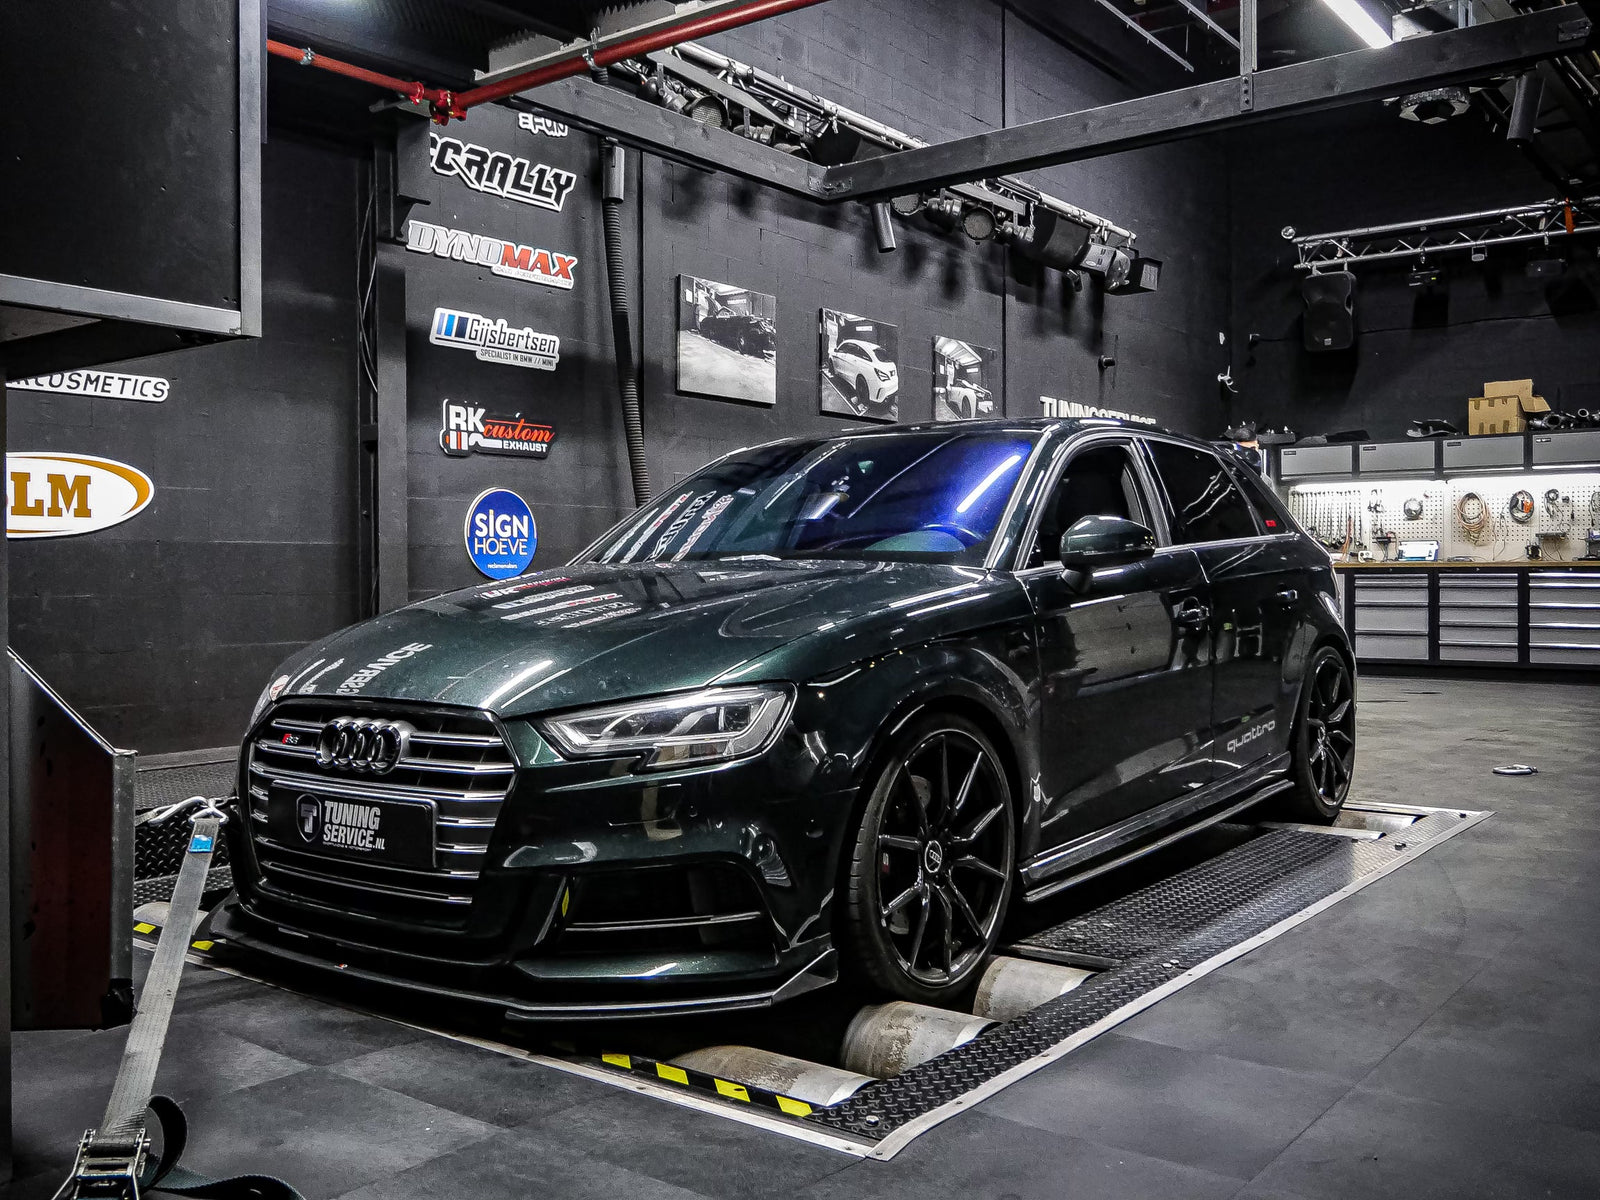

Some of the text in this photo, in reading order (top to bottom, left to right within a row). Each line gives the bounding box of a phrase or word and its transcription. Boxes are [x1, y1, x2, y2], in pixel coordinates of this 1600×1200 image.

[408, 222, 576, 281] DYNOMAX
[469, 318, 557, 353] Gijsbertsen
[480, 349, 512, 360] SPECIALIST
[15, 372, 166, 398] COSMETICS
[449, 404, 486, 433] RK
[483, 418, 556, 443] custom
[503, 440, 548, 453] EXHAUST
[474, 509, 529, 538] SIGN
[474, 538, 528, 556] HOEVE
[1227, 720, 1276, 752] quattro
[324, 800, 381, 830] TUNING
[323, 823, 385, 850] SERVICE.NL
